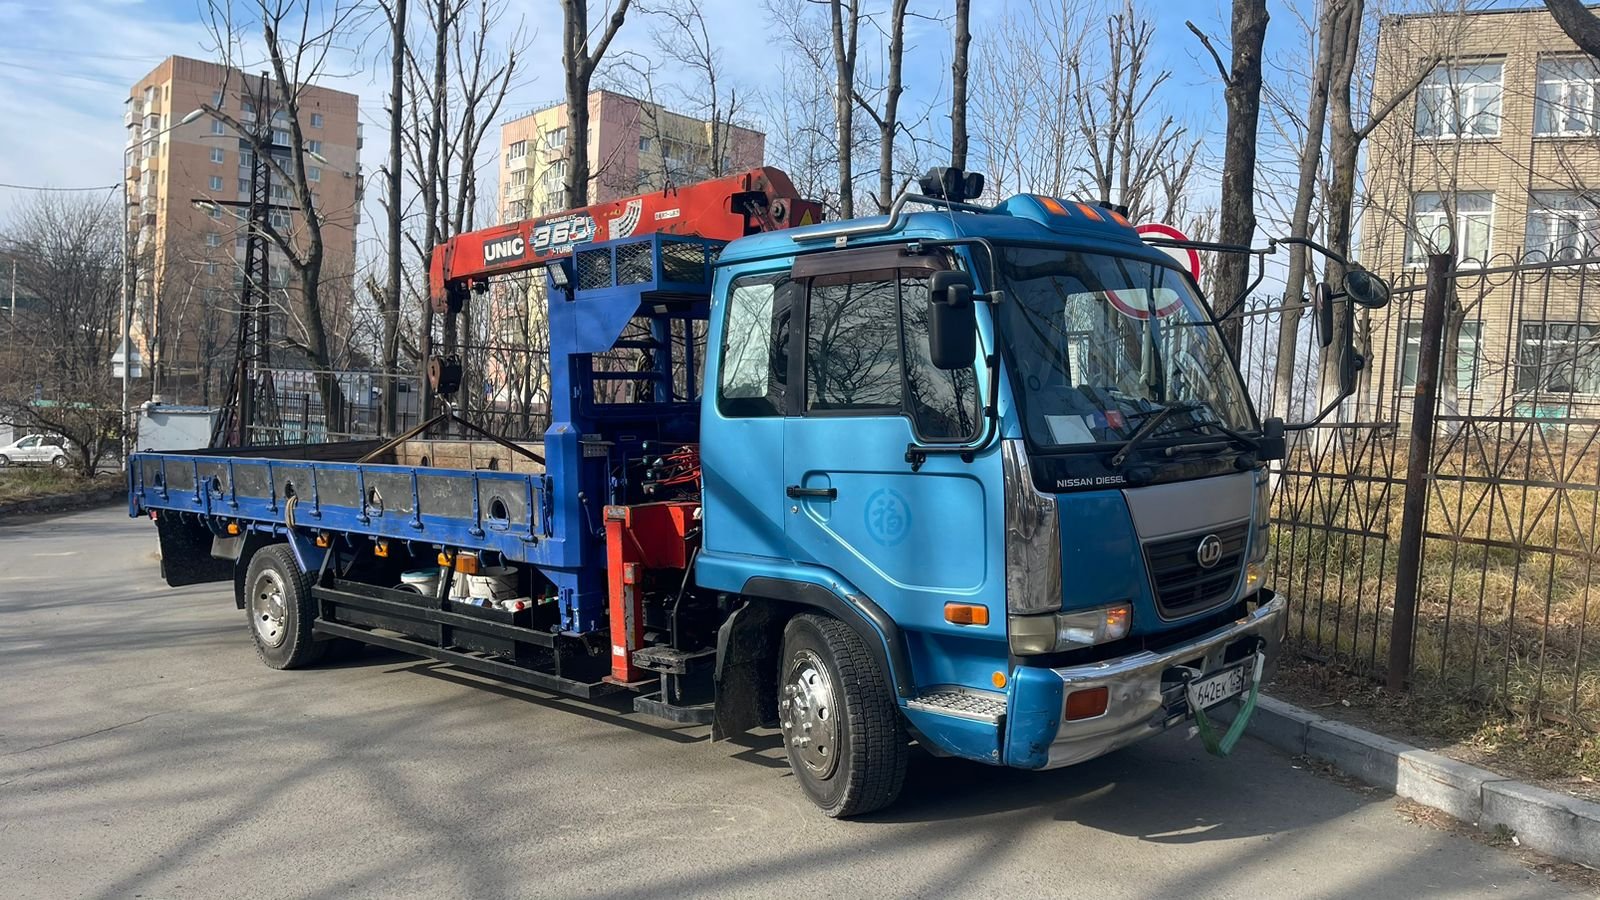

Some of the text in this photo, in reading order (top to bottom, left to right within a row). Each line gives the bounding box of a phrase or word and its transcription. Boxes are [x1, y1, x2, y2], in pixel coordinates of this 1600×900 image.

[484, 237, 524, 261] UNIC
[1056, 475, 1127, 488] NISSAN DIESEL
